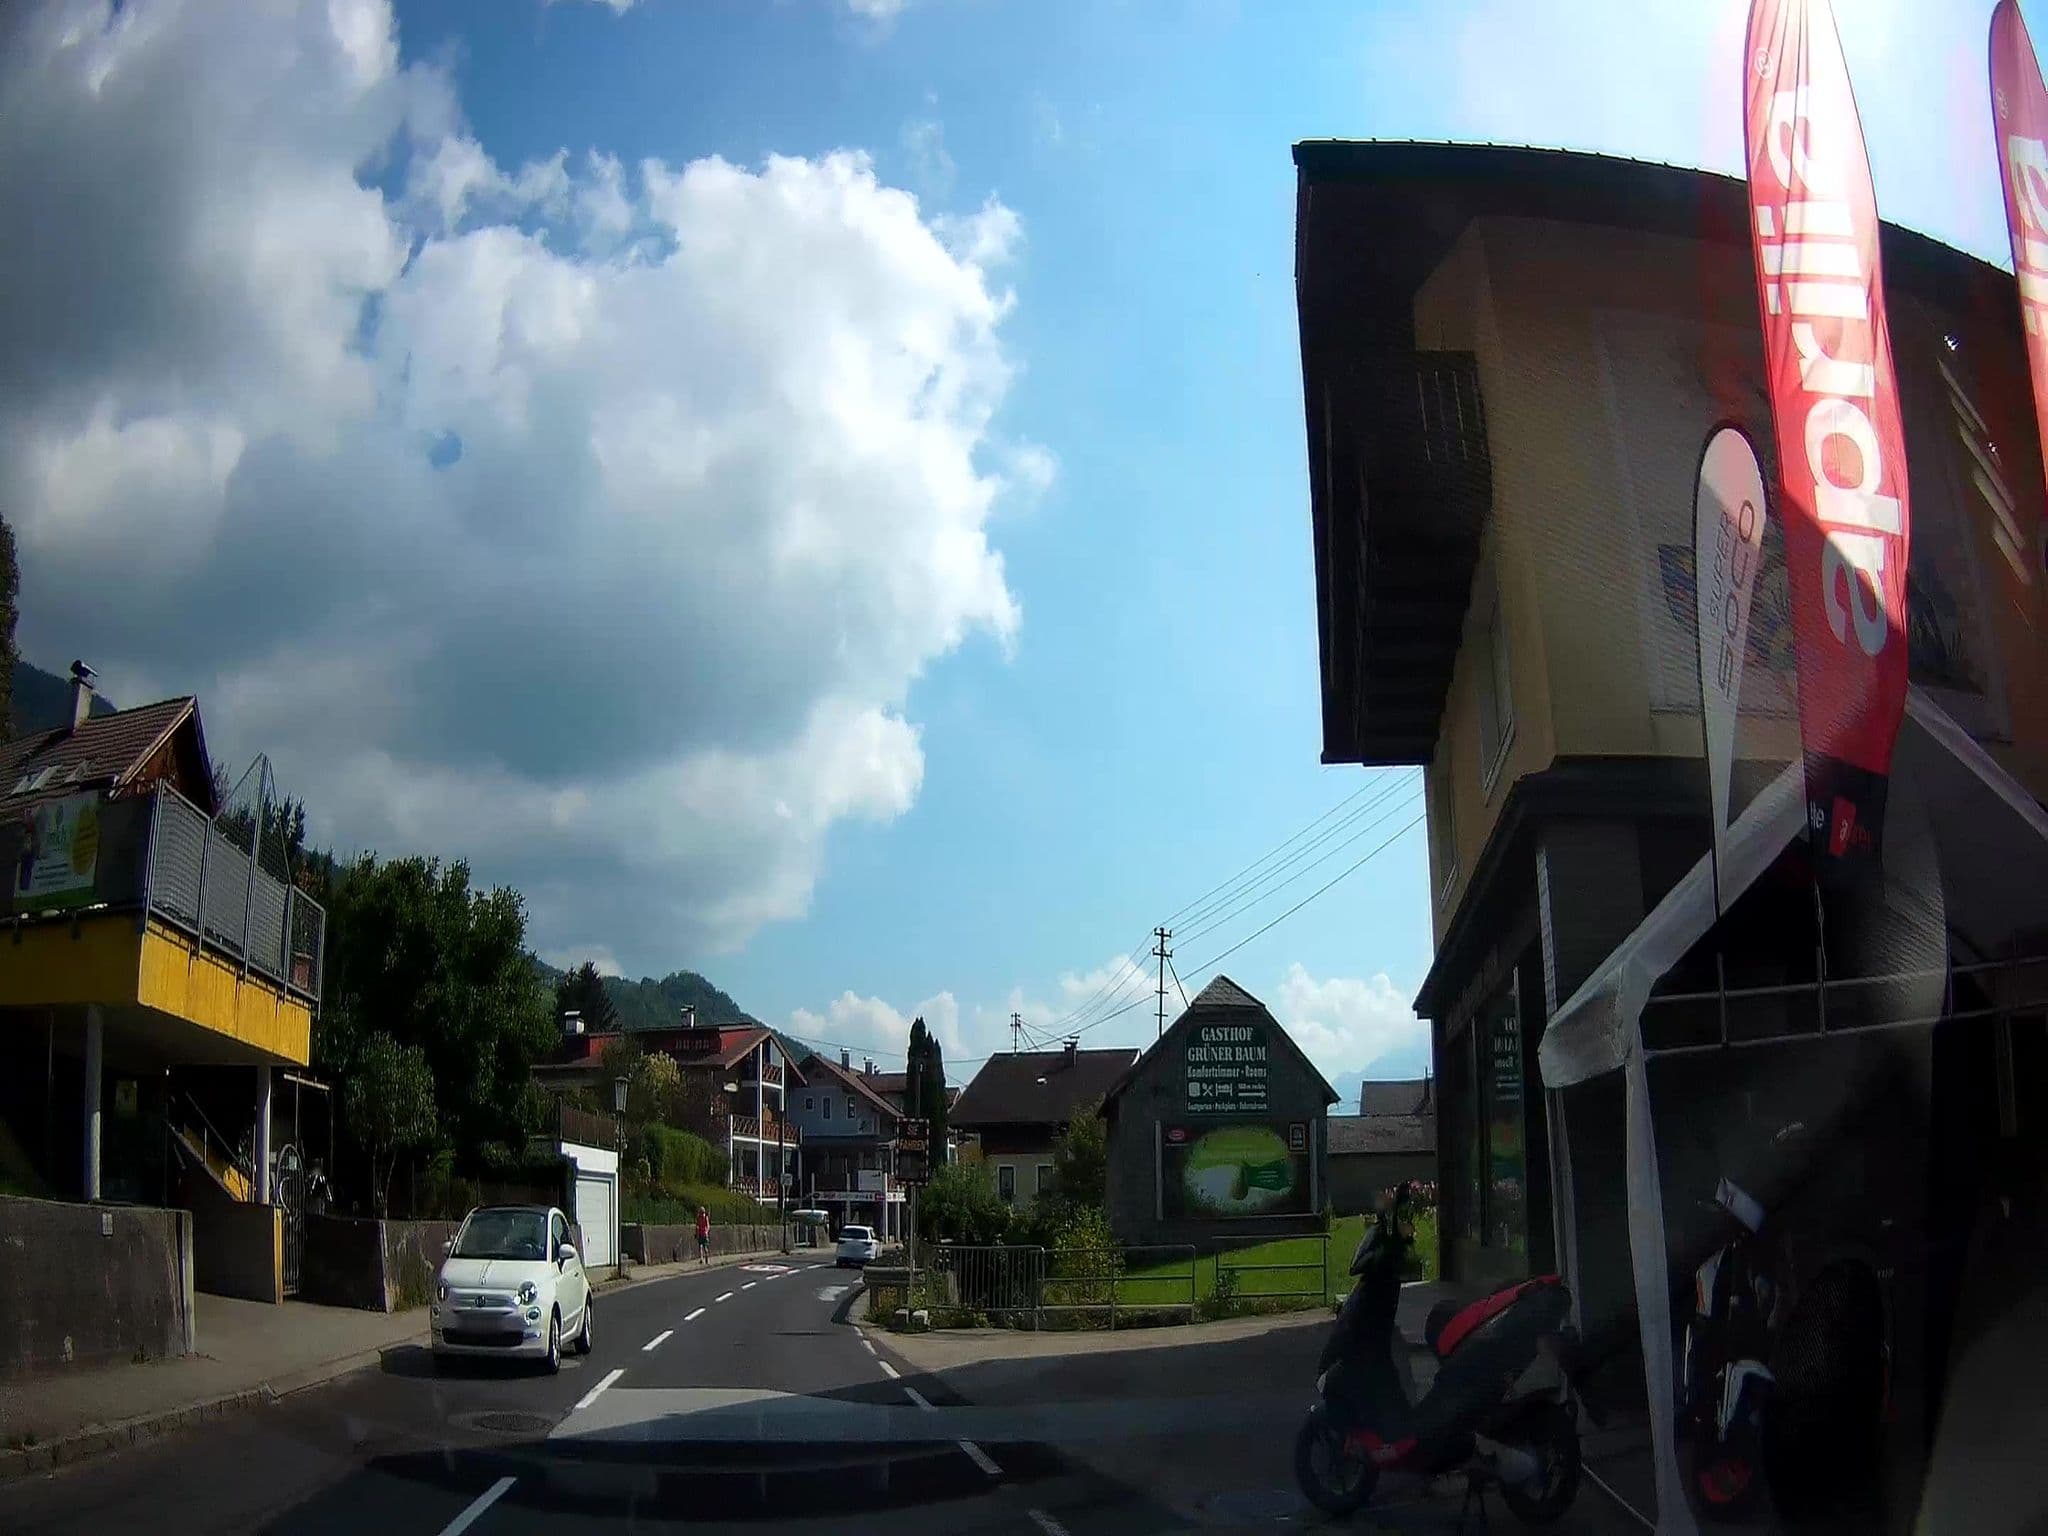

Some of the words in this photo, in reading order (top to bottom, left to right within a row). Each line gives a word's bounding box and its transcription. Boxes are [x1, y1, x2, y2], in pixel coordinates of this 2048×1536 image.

[1756, 86, 1903, 658] aprilia
[1709, 510, 1730, 621] SUPER
[1718, 499, 1755, 701] SOCO
[1188, 1042, 1234, 1061] GRÜNER
[1235, 1046, 1267, 1061] BAUM
[1201, 1026, 1254, 1042] GASTHOF
